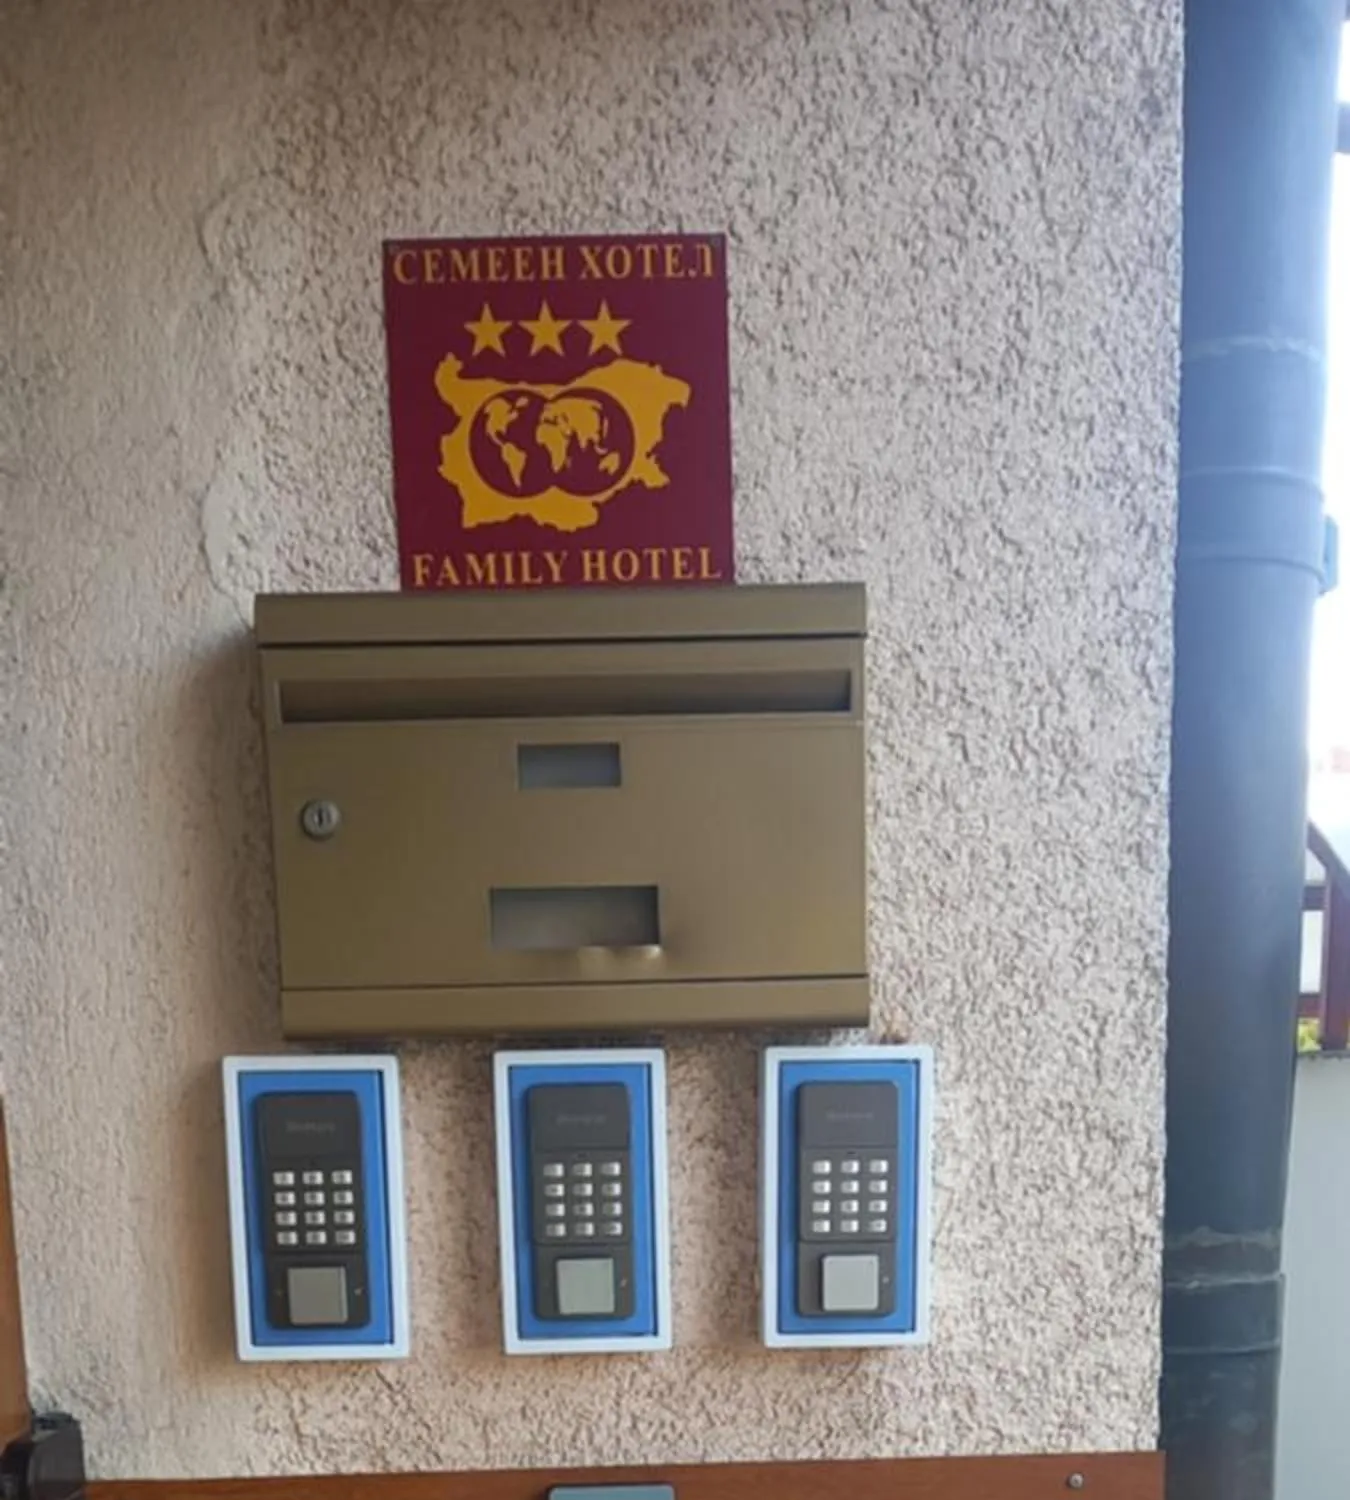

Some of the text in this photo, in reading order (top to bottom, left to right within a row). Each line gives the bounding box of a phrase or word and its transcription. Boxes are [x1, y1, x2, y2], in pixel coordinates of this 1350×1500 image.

[393, 244, 714, 284] СЕМЕЕН ХОТЕЛ
[413, 547, 722, 586] FAMILY HOTEL
